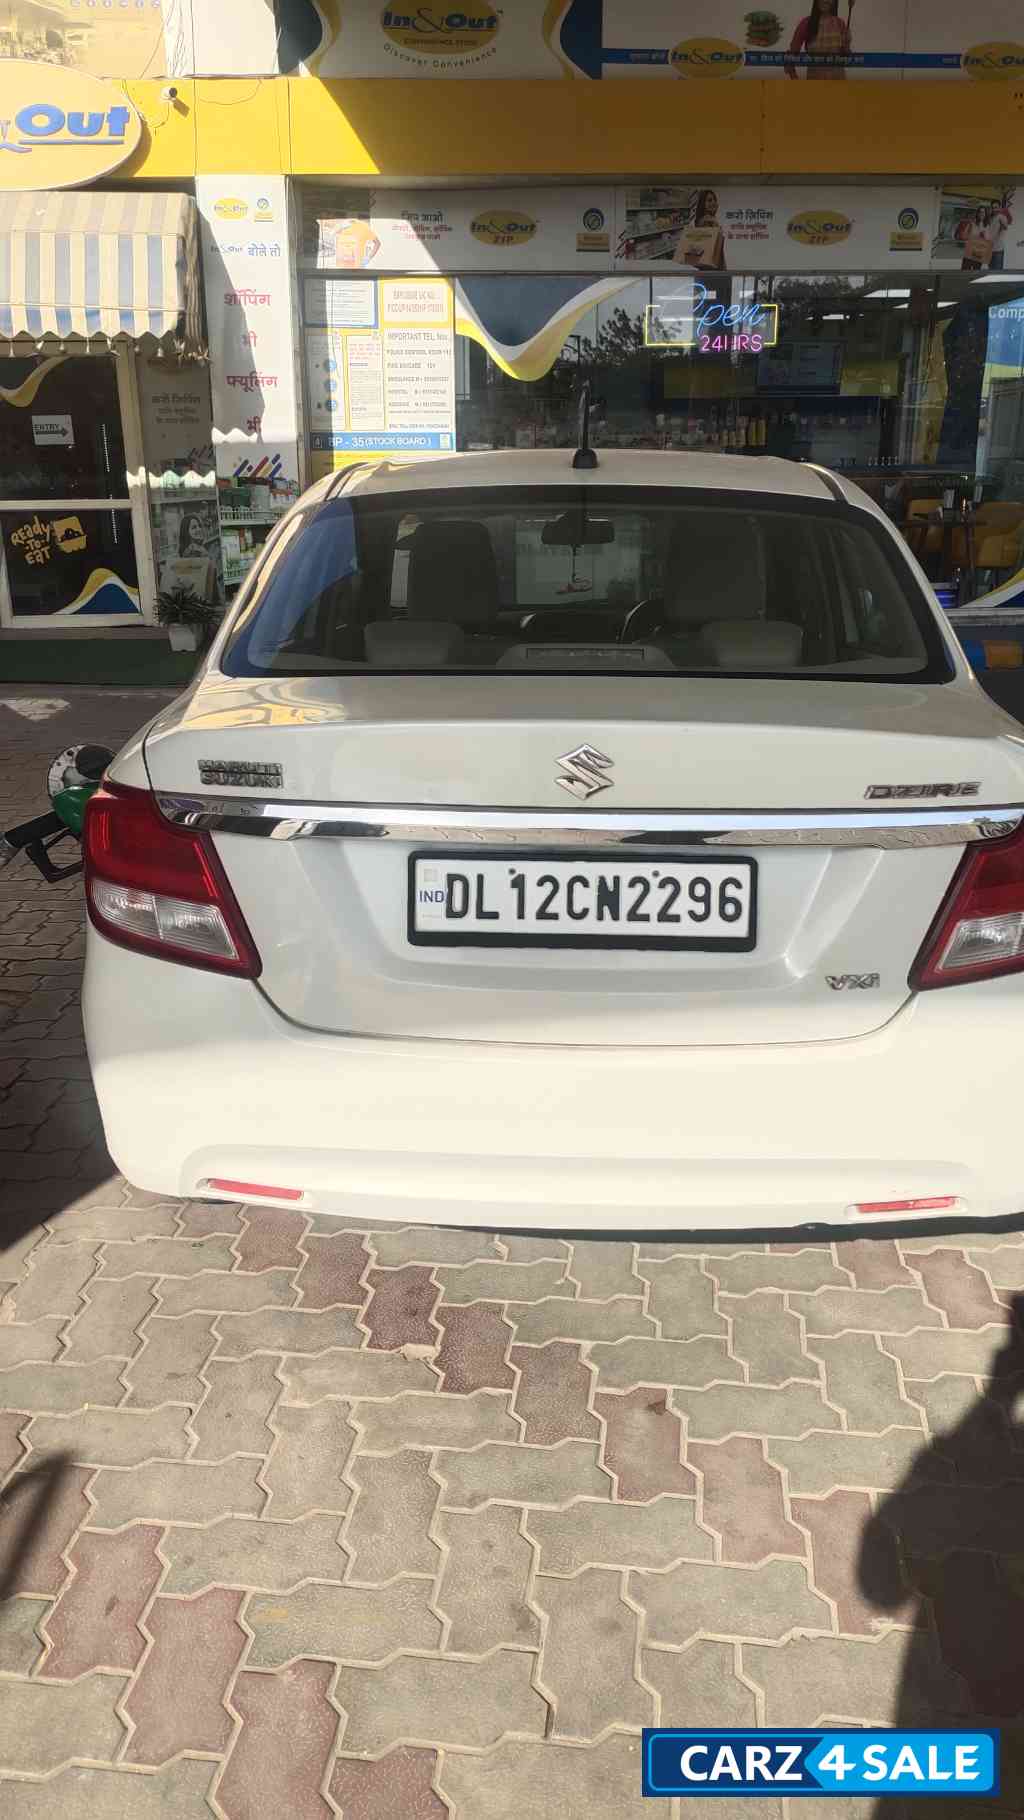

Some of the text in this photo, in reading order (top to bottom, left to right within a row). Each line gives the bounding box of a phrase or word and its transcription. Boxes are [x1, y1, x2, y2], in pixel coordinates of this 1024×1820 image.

[383, 8, 497, 33] In&Out
[383, 43, 497, 68] Discover Convenience
[671, 48, 743, 66] In&Out
[0, 104, 130, 153] Out
[470, 219, 536, 233] In&Out
[787, 220, 850, 235] In&Out
[269, 242, 281, 257] तो
[224, 288, 272, 306] शॉपिंग
[33, 424, 60, 433] ENTRY
[198, 760, 282, 776] MARUTI
[200, 772, 284, 788] SUZUKI
[865, 782, 980, 800] DZIRE
[419, 890, 445, 903] IND
[446, 873, 743, 923] DL12CN2296
